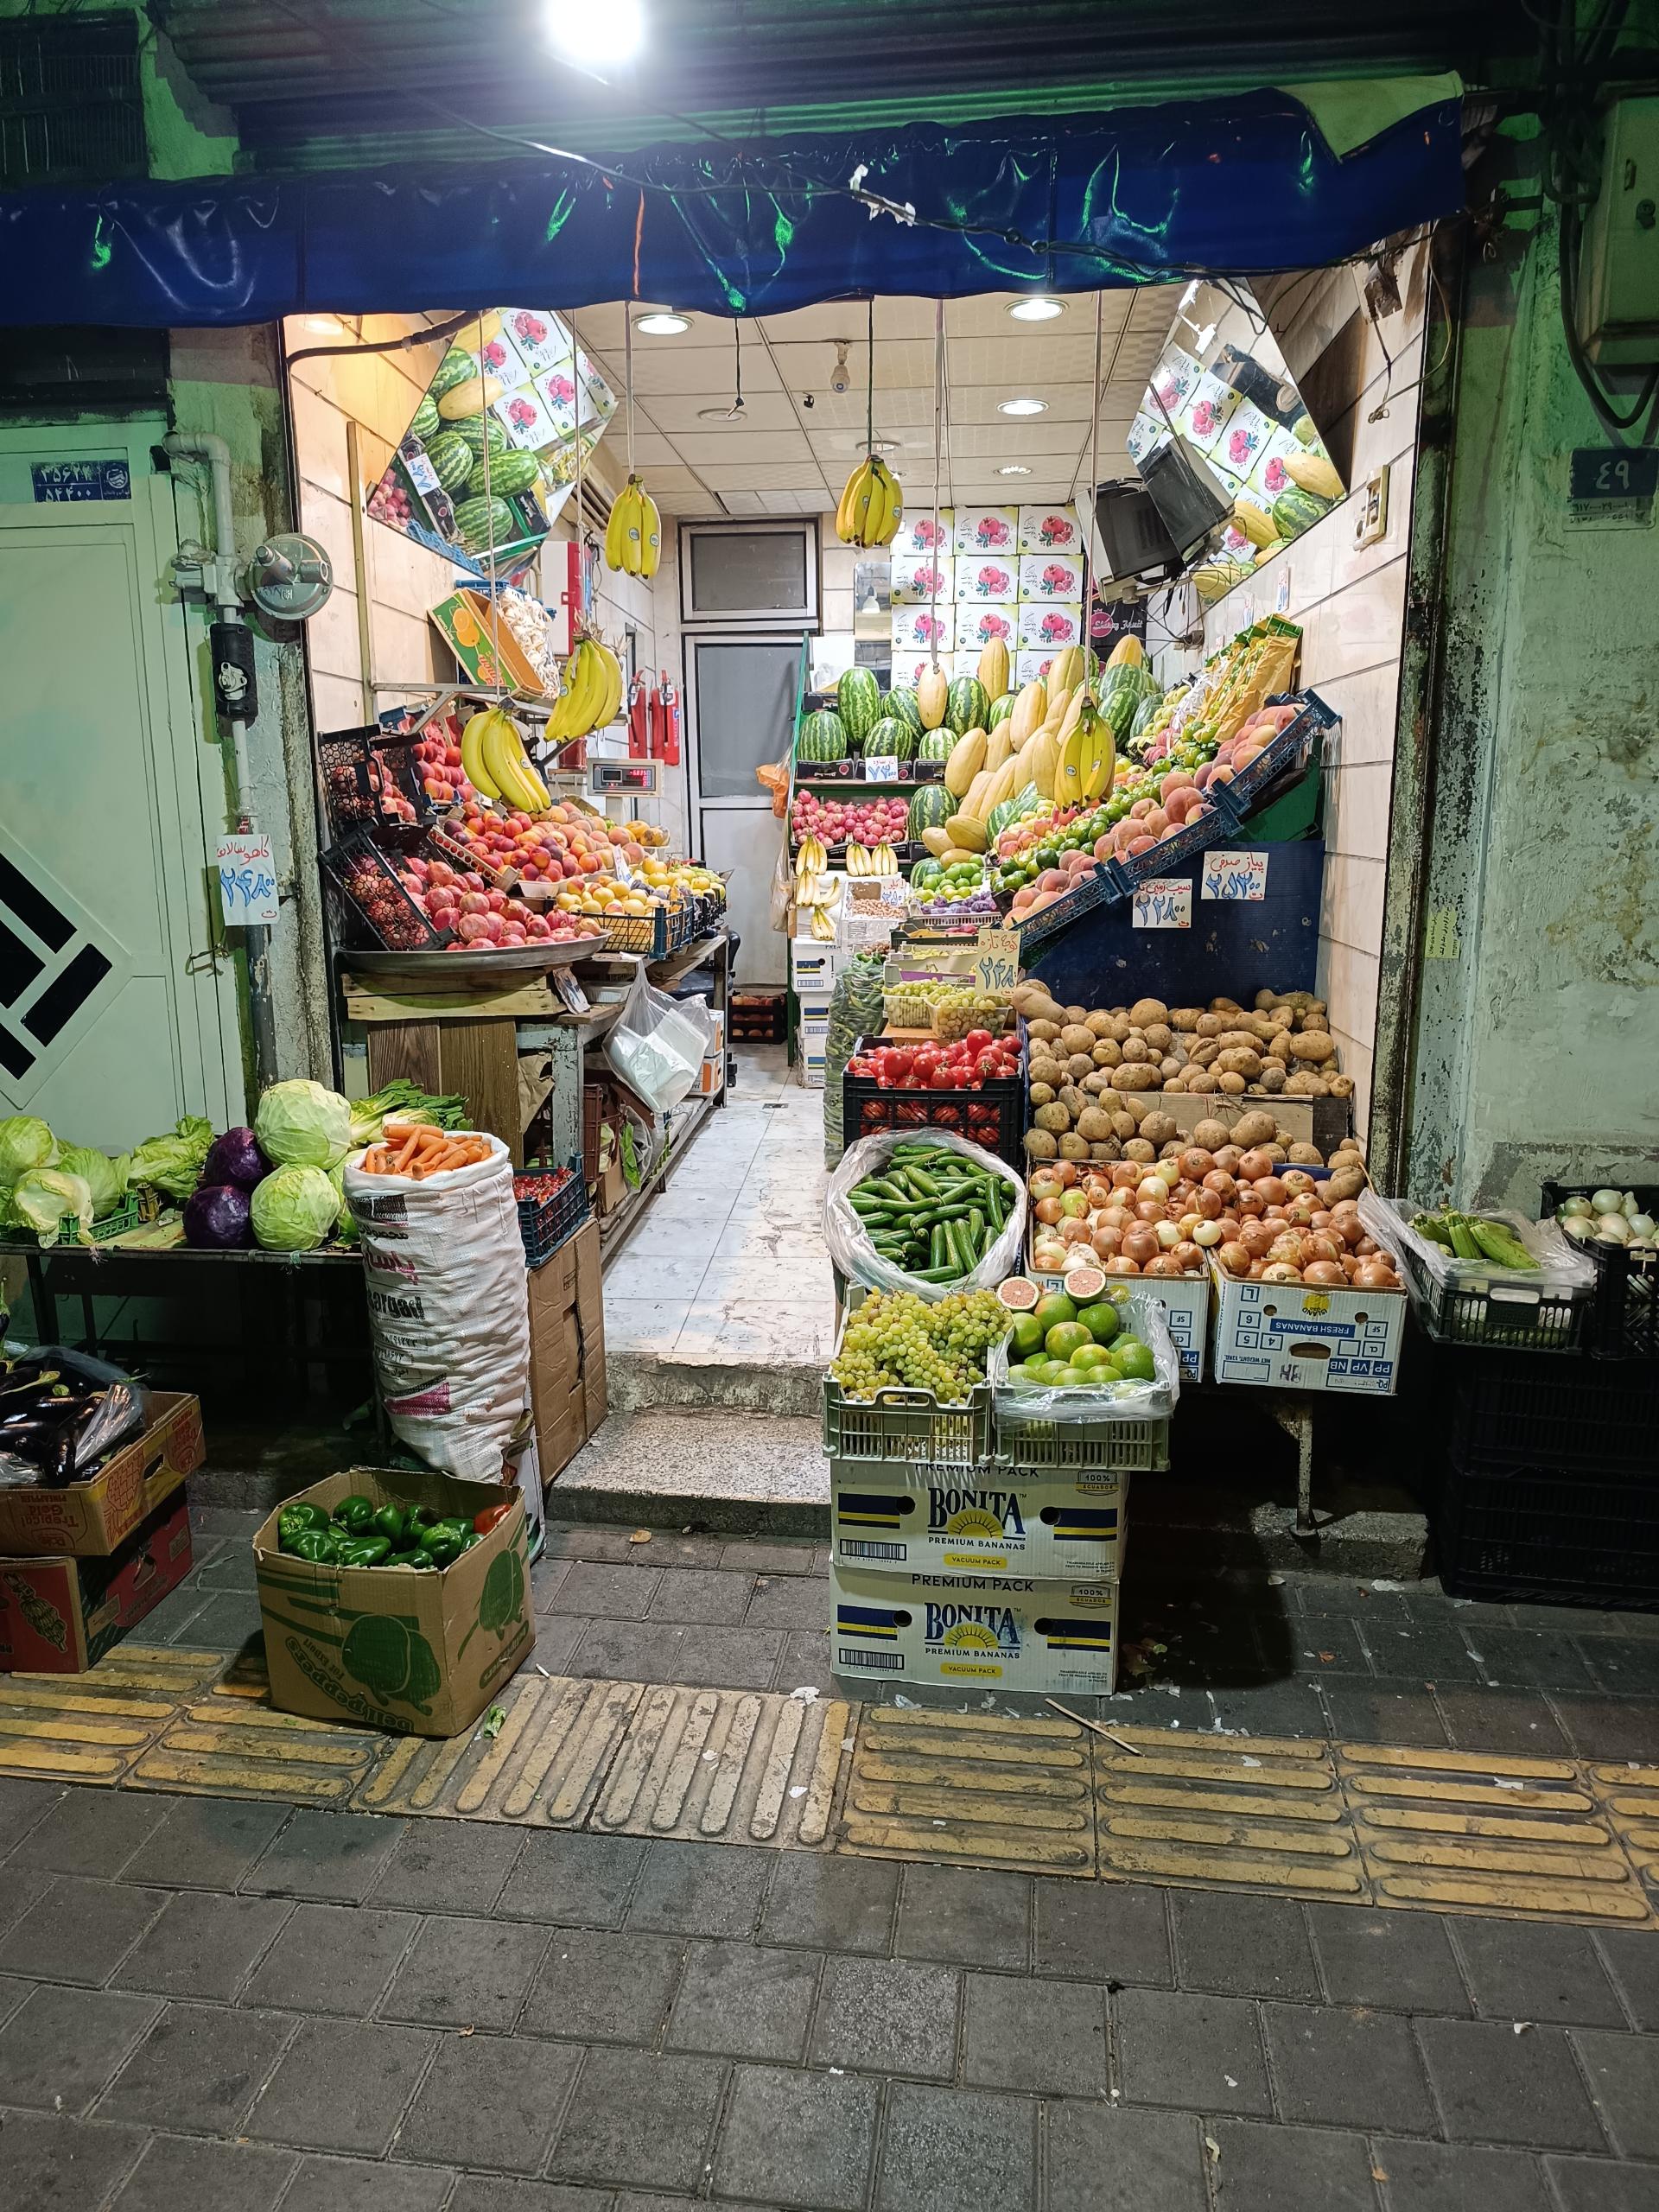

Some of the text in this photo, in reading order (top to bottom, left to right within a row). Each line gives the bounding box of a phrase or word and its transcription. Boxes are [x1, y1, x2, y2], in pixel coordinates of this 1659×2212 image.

[1240, 852, 1264, 874] پیاز
[1166, 884, 1192, 895] سیب
[980, 930, 999, 953] تازه
[1247, 1288, 1254, 1299] L
[1301, 1307, 1328, 1317] ISLAND
[1246, 1315, 1253, 1324] 6
[1274, 1322, 1350, 1334] FRESH BANANAS
[1243, 1336, 1250, 1344] 5
[1268, 1337, 1275, 1345] 4
[1182, 1354, 1198, 1363] PP
[1330, 1361, 1346, 1370] NB
[1353, 1363, 1368, 1372] VP
[1375, 1363, 1389, 1372] PP
[999, 1466, 1039, 1478] PACK
[927, 1487, 1026, 1535] BONITA
[928, 1536, 1026, 1551] PREMIUM BANANAS
[951, 1556, 981, 1565] VACUUM
[912, 1574, 1033, 1592] PREMIUM PACK
[924, 1602, 1020, 1643] BONITA
[925, 1648, 1020, 1659] PREMIUM BANANAS
[285, 1637, 367, 1716] peppers
